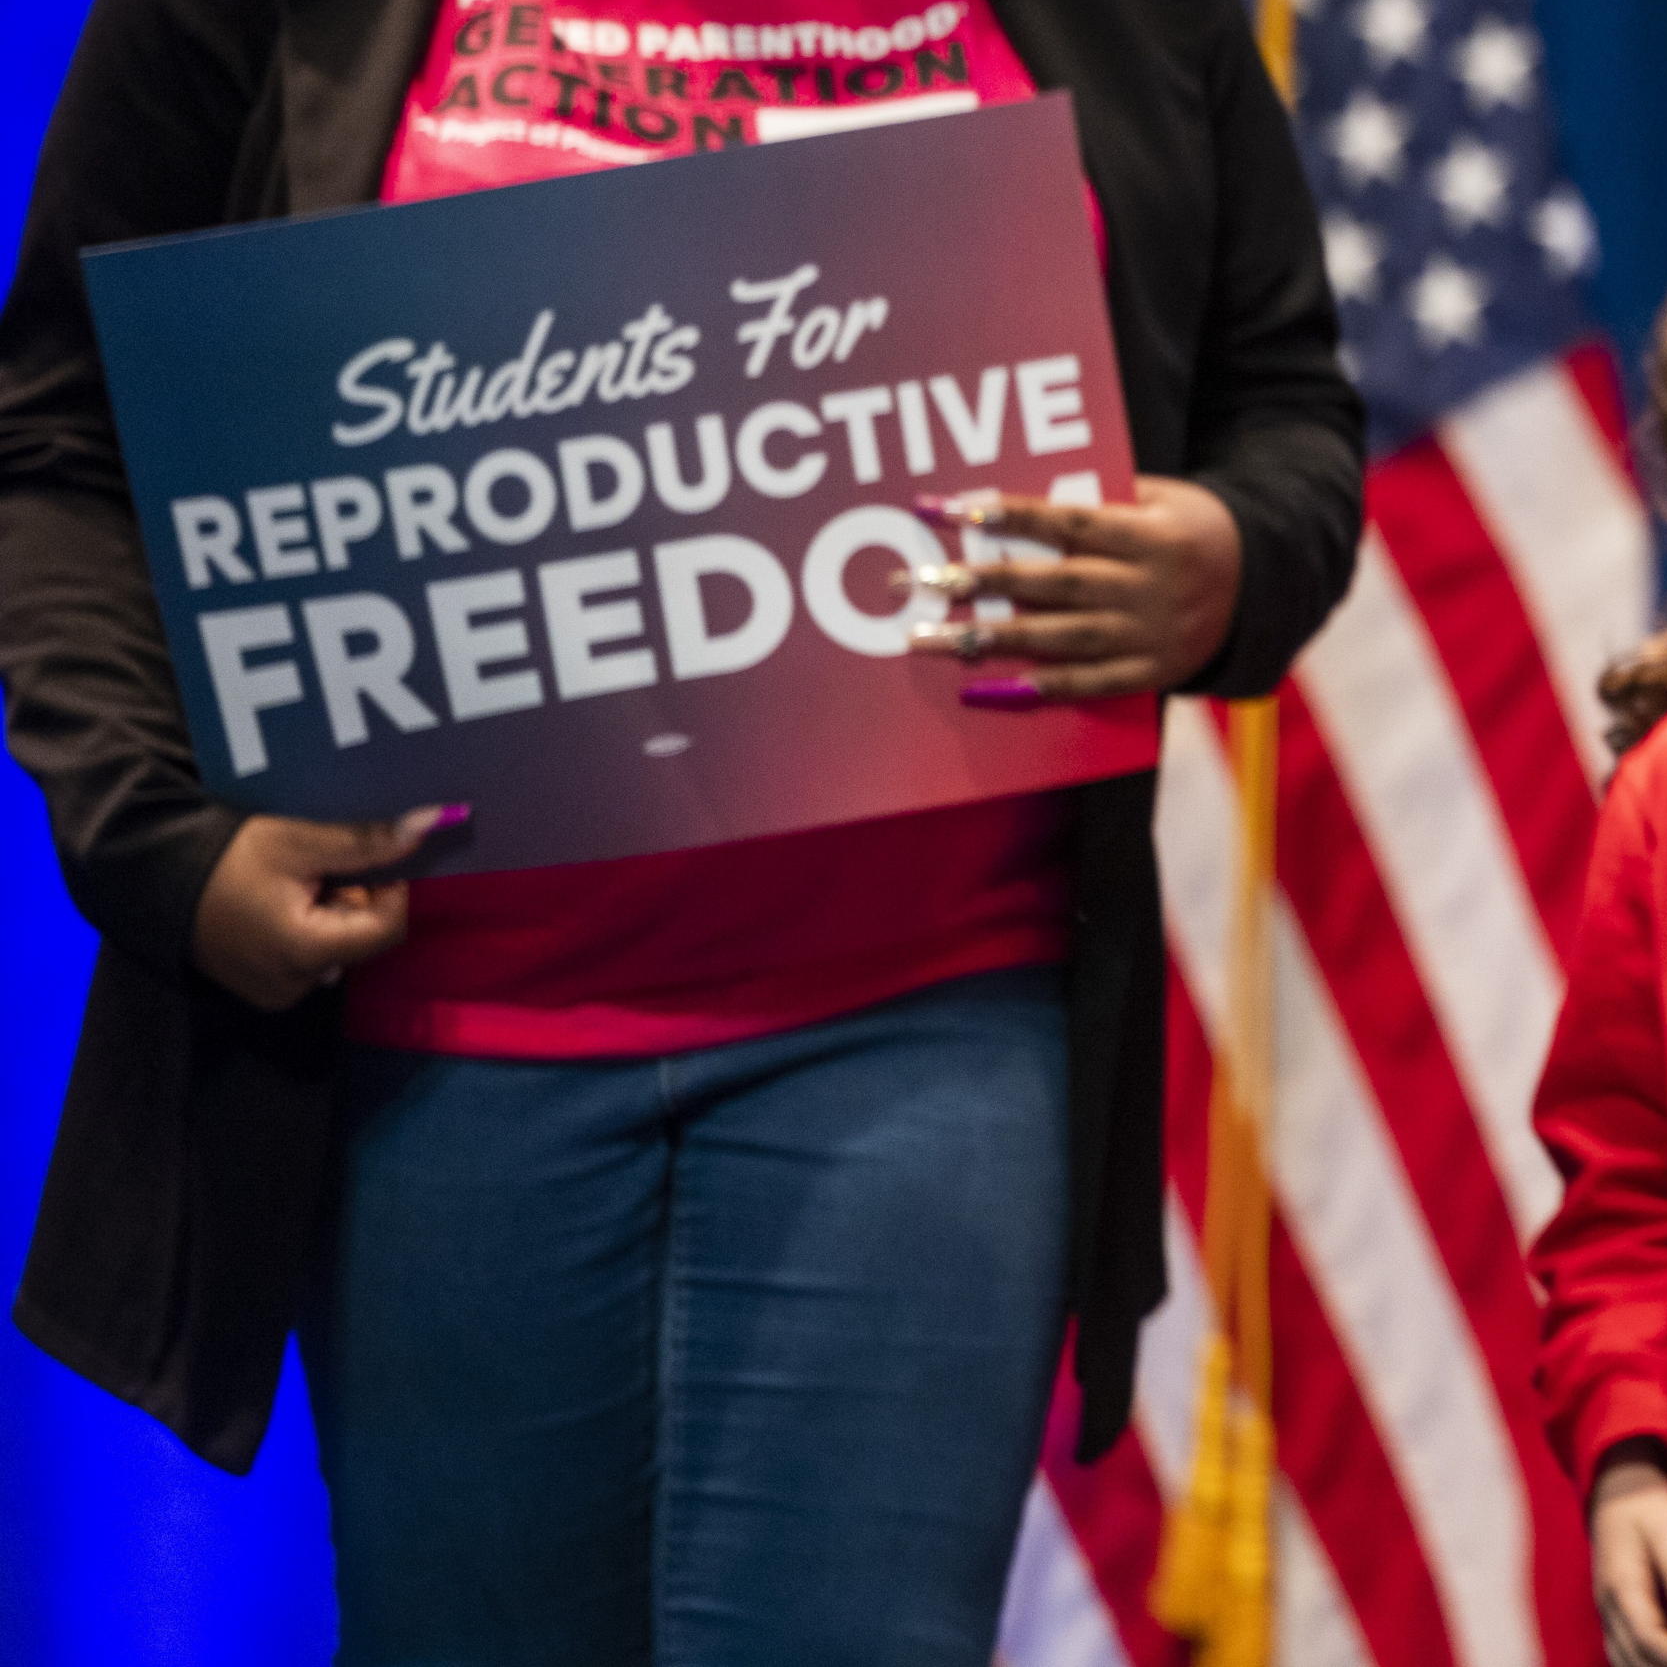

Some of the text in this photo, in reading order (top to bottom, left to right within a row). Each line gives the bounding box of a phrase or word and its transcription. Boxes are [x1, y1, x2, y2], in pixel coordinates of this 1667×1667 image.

[636, 1, 968, 62] PARENTHOOD
[436, 63, 742, 155] ACTION
[332, 263, 888, 447] Students For
[170, 355, 1092, 590] REPRODUCTIVE
